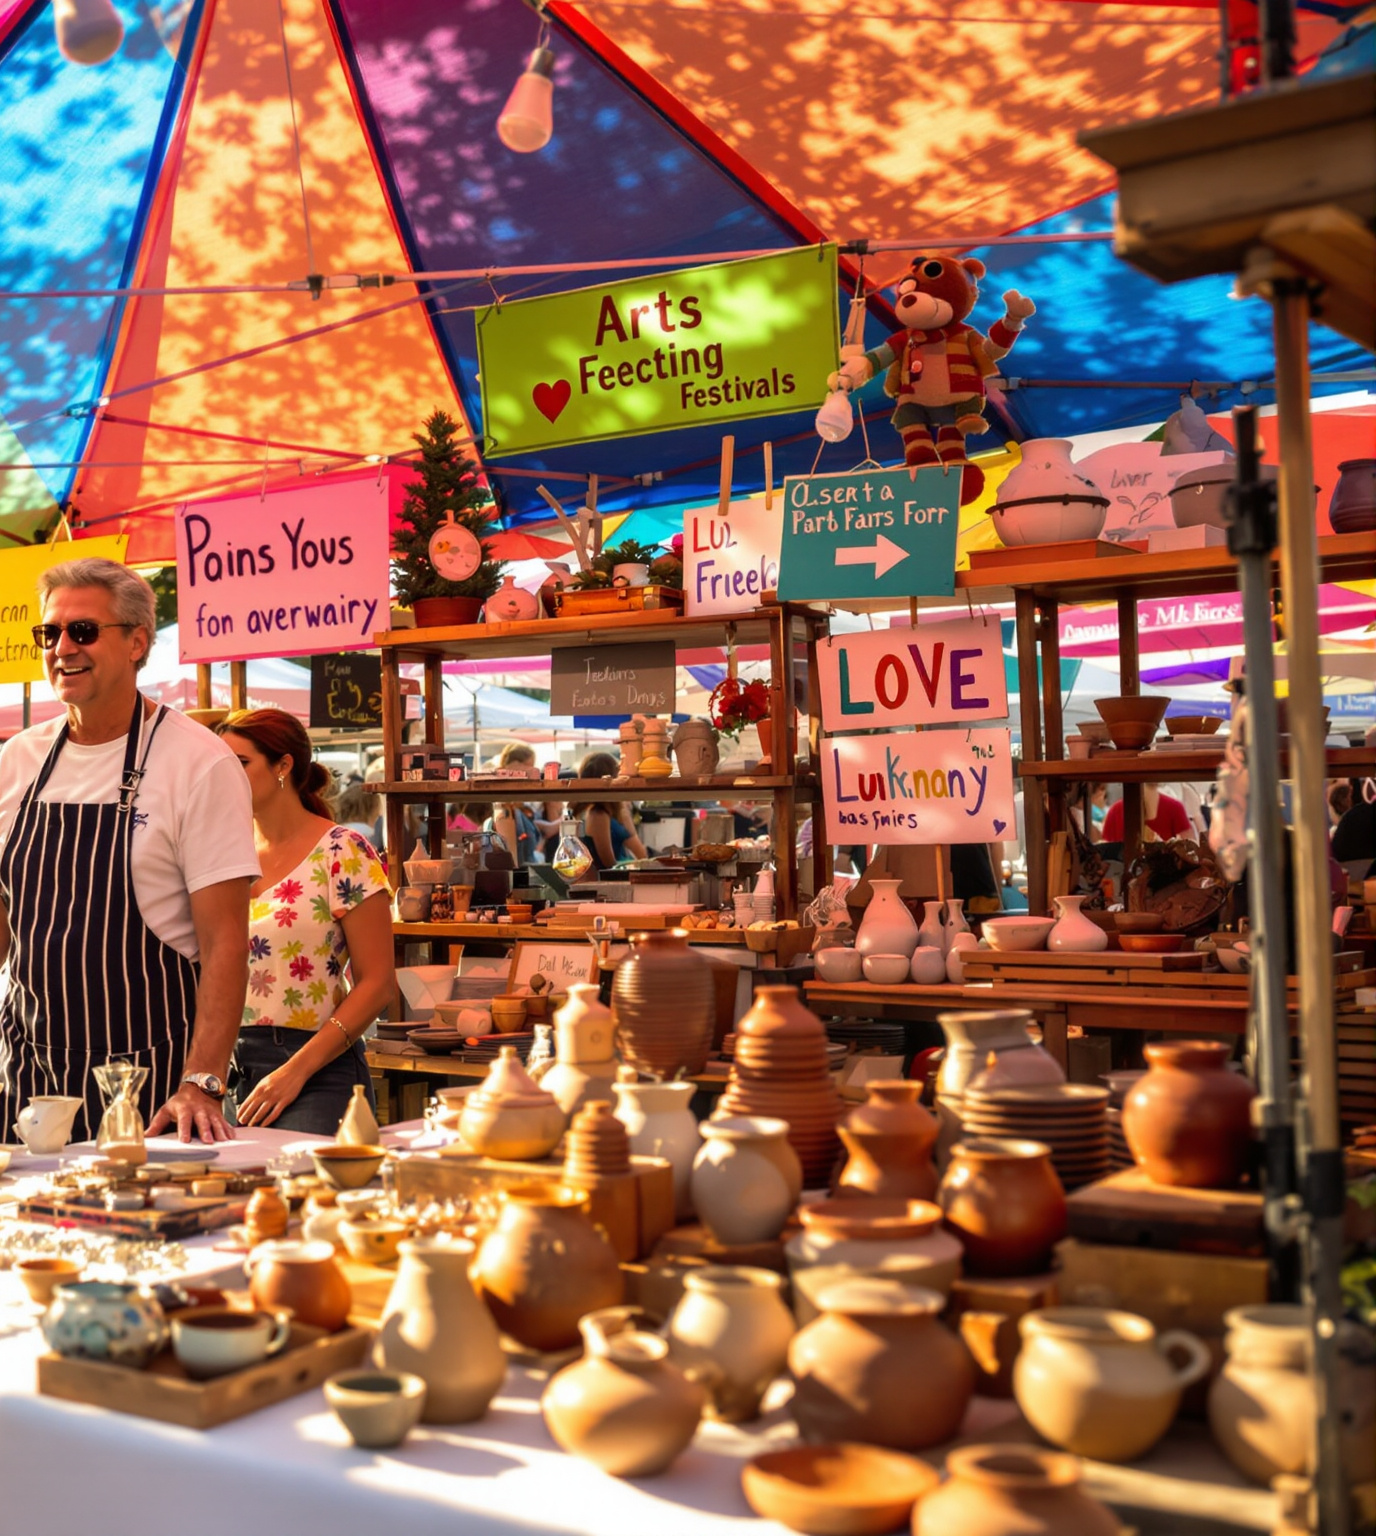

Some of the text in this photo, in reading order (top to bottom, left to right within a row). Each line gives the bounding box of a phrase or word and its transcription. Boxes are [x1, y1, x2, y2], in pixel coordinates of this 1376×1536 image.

[594, 291, 703, 346] Arts
[579, 342, 724, 395] Feecting
[681, 367, 796, 410] Festivals
[281, 517, 354, 570] Yous
[196, 603, 233, 637] fon
[838, 642, 990, 715] LOVE
